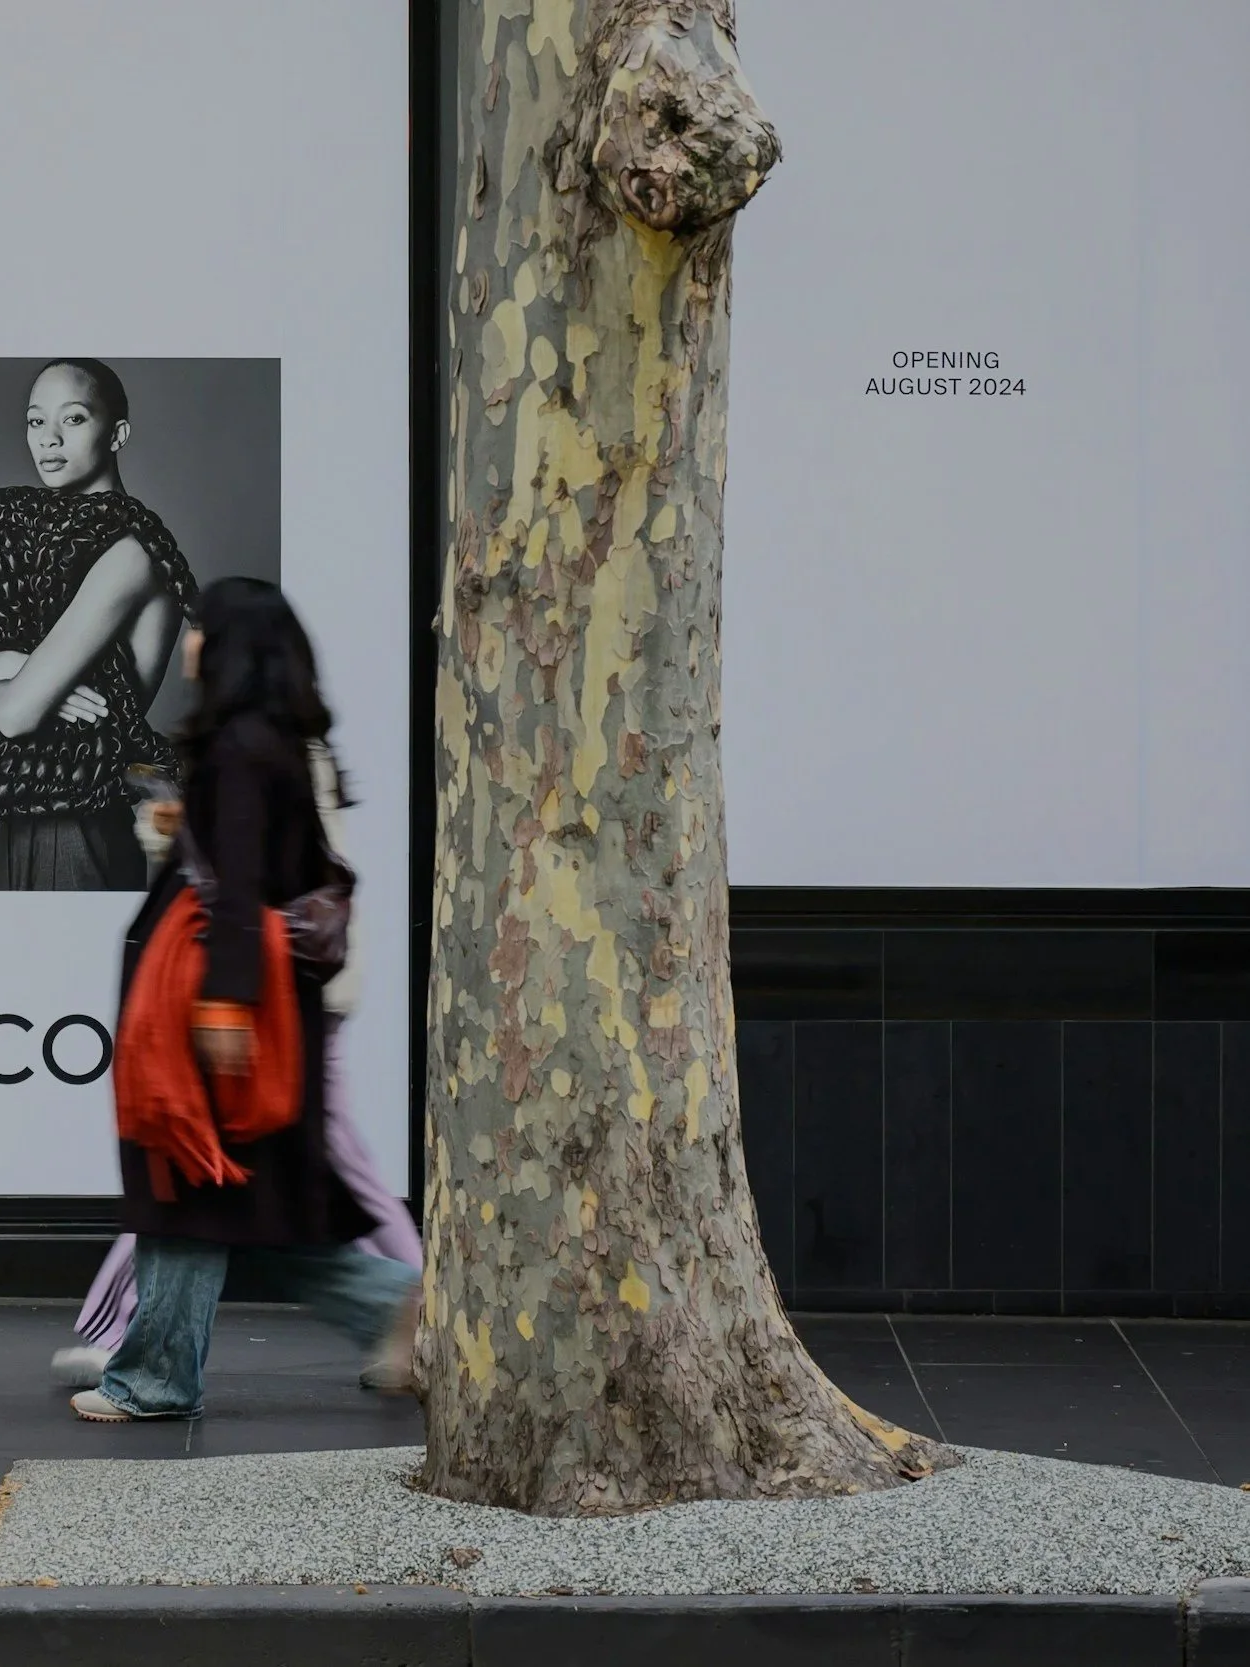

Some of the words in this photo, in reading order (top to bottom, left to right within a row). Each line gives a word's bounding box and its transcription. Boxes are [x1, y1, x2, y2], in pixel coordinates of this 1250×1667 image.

[892, 351, 1000, 369] OPENING
[865, 377, 962, 396] AUGUST
[968, 377, 1027, 396] 2024
